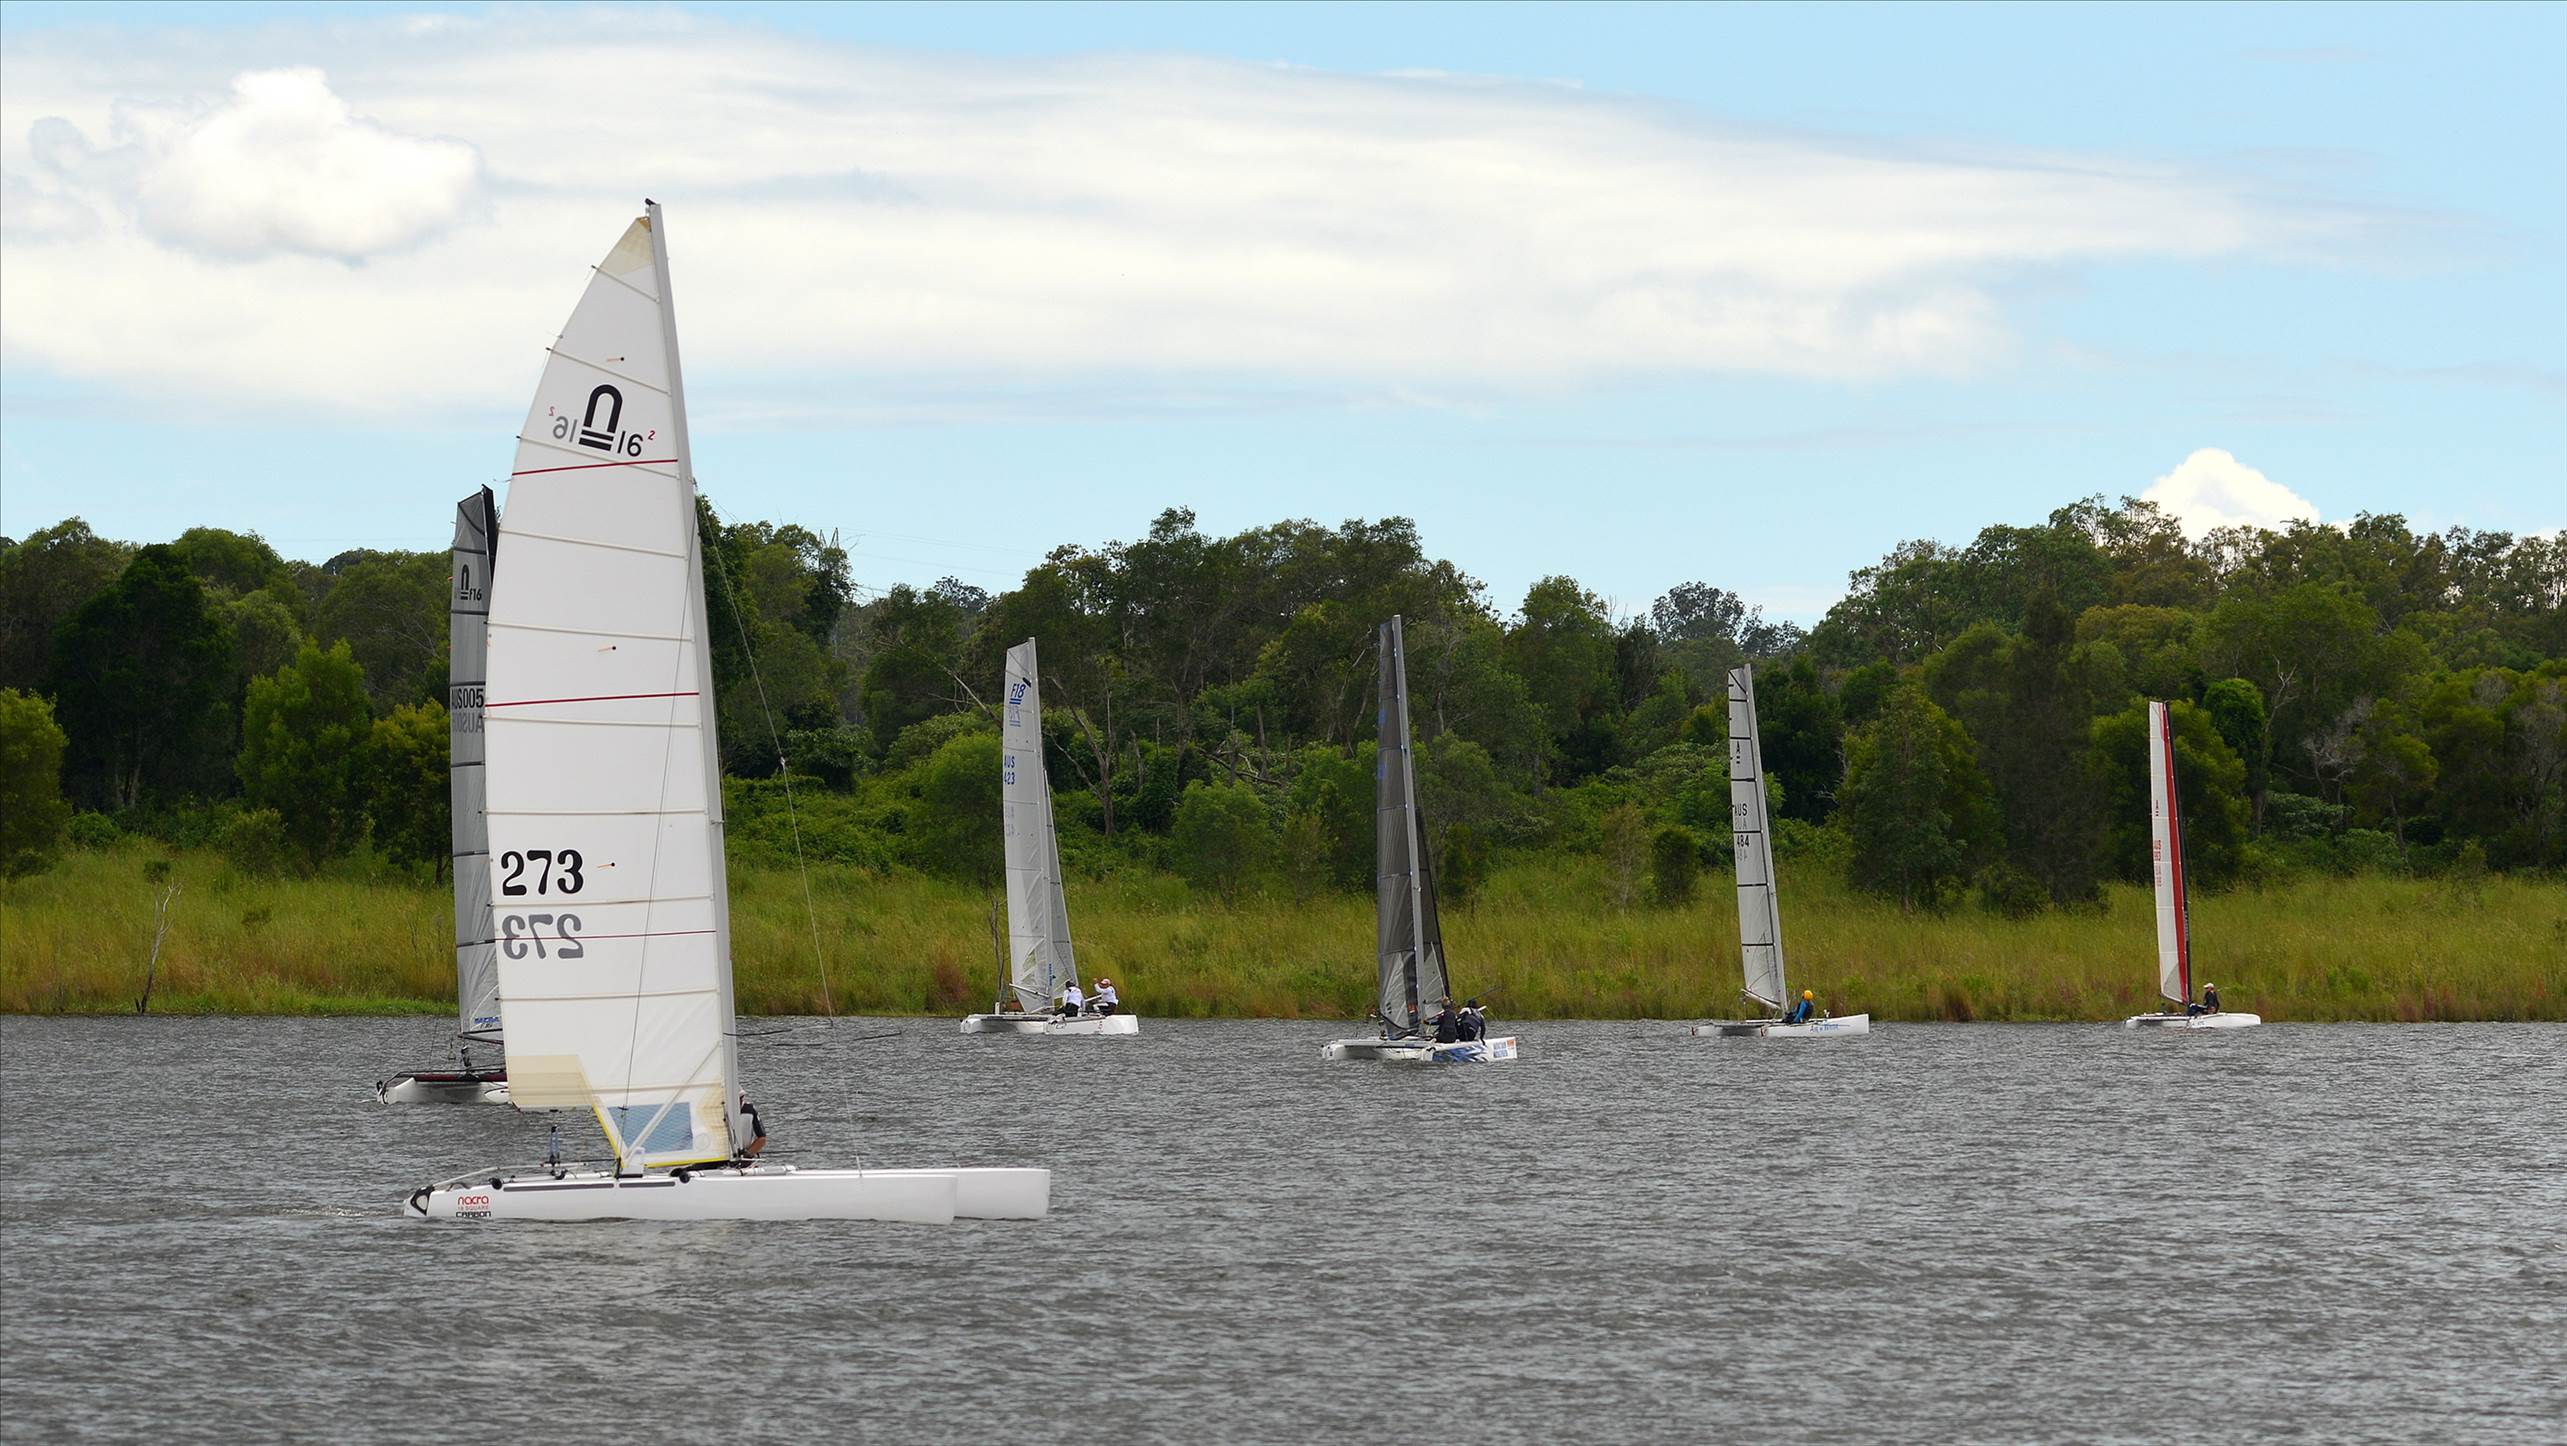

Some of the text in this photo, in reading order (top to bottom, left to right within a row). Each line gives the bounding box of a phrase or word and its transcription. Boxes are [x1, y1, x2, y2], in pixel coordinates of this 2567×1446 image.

[617, 430, 644, 457] 16
[452, 687, 485, 709] S005
[1010, 683, 1026, 698] F18
[1734, 803, 1748, 817] AUS
[501, 849, 584, 896] 273
